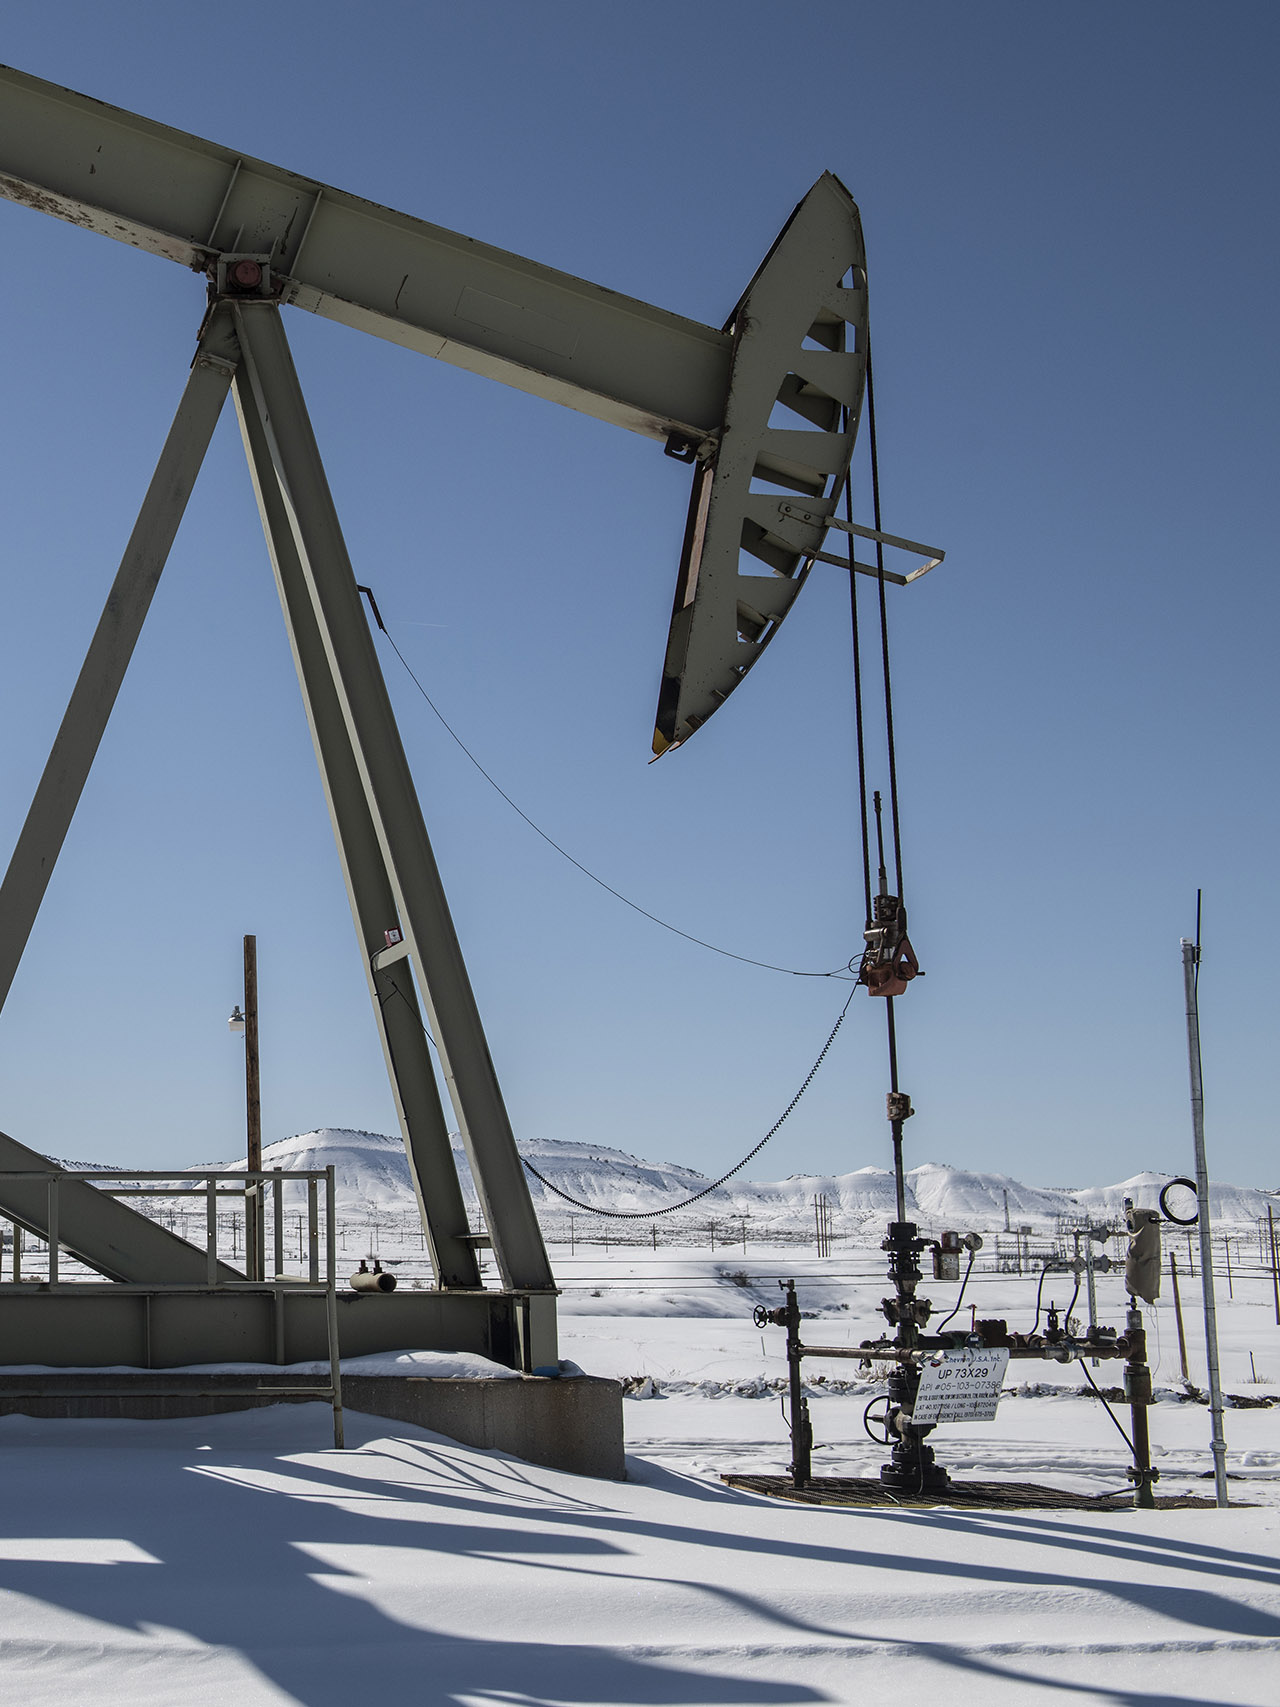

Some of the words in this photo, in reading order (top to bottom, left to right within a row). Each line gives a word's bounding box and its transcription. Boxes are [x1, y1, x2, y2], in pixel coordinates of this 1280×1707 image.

[938, 1369, 953, 1380] UP
[955, 1367, 989, 1379] 73X29
[920, 1383, 933, 1392] API
